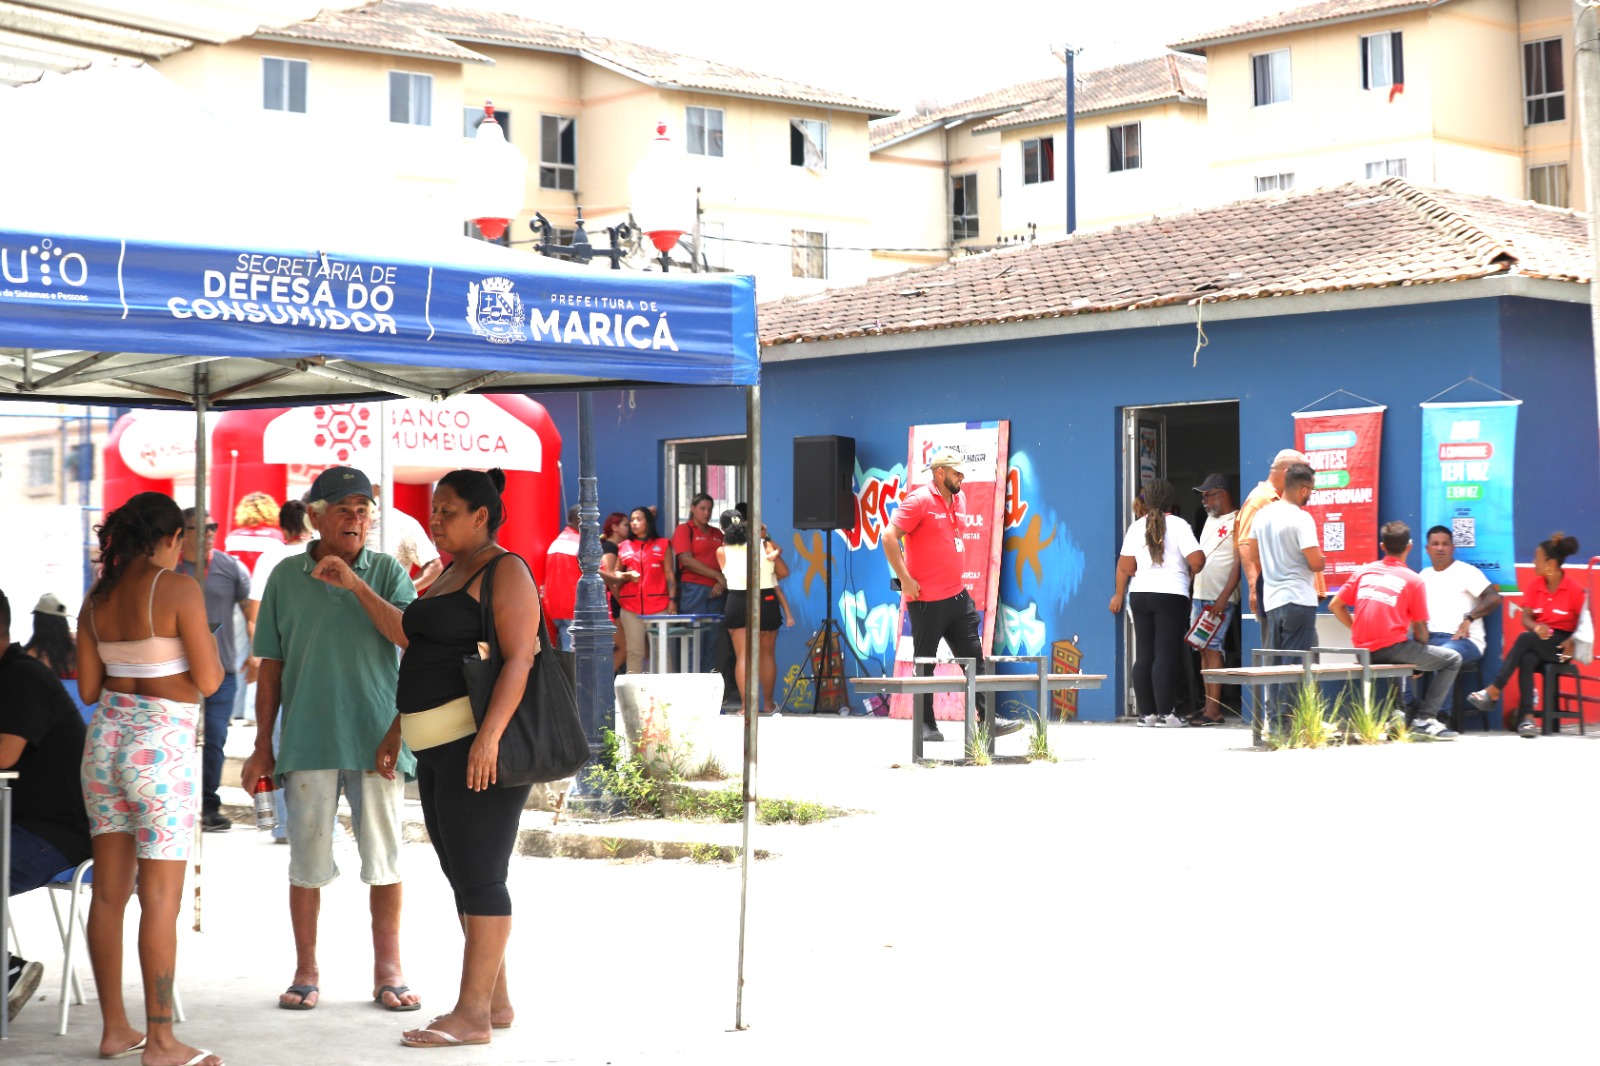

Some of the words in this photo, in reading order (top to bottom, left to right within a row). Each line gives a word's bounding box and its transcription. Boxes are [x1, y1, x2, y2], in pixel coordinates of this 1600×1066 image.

[236, 253, 363, 283] SECRETARIA
[370, 266, 397, 285] DE
[14, 290, 50, 300] Sistemas
[57, 292, 89, 302] Pessoas
[203, 270, 336, 308] DEFESA
[347, 283, 394, 312] DO
[551, 294, 634, 310] PREFEITURA
[639, 300, 658, 312] DE
[167, 297, 397, 335] CONSUMIDOR
[530, 308, 679, 352] MARICÁ
